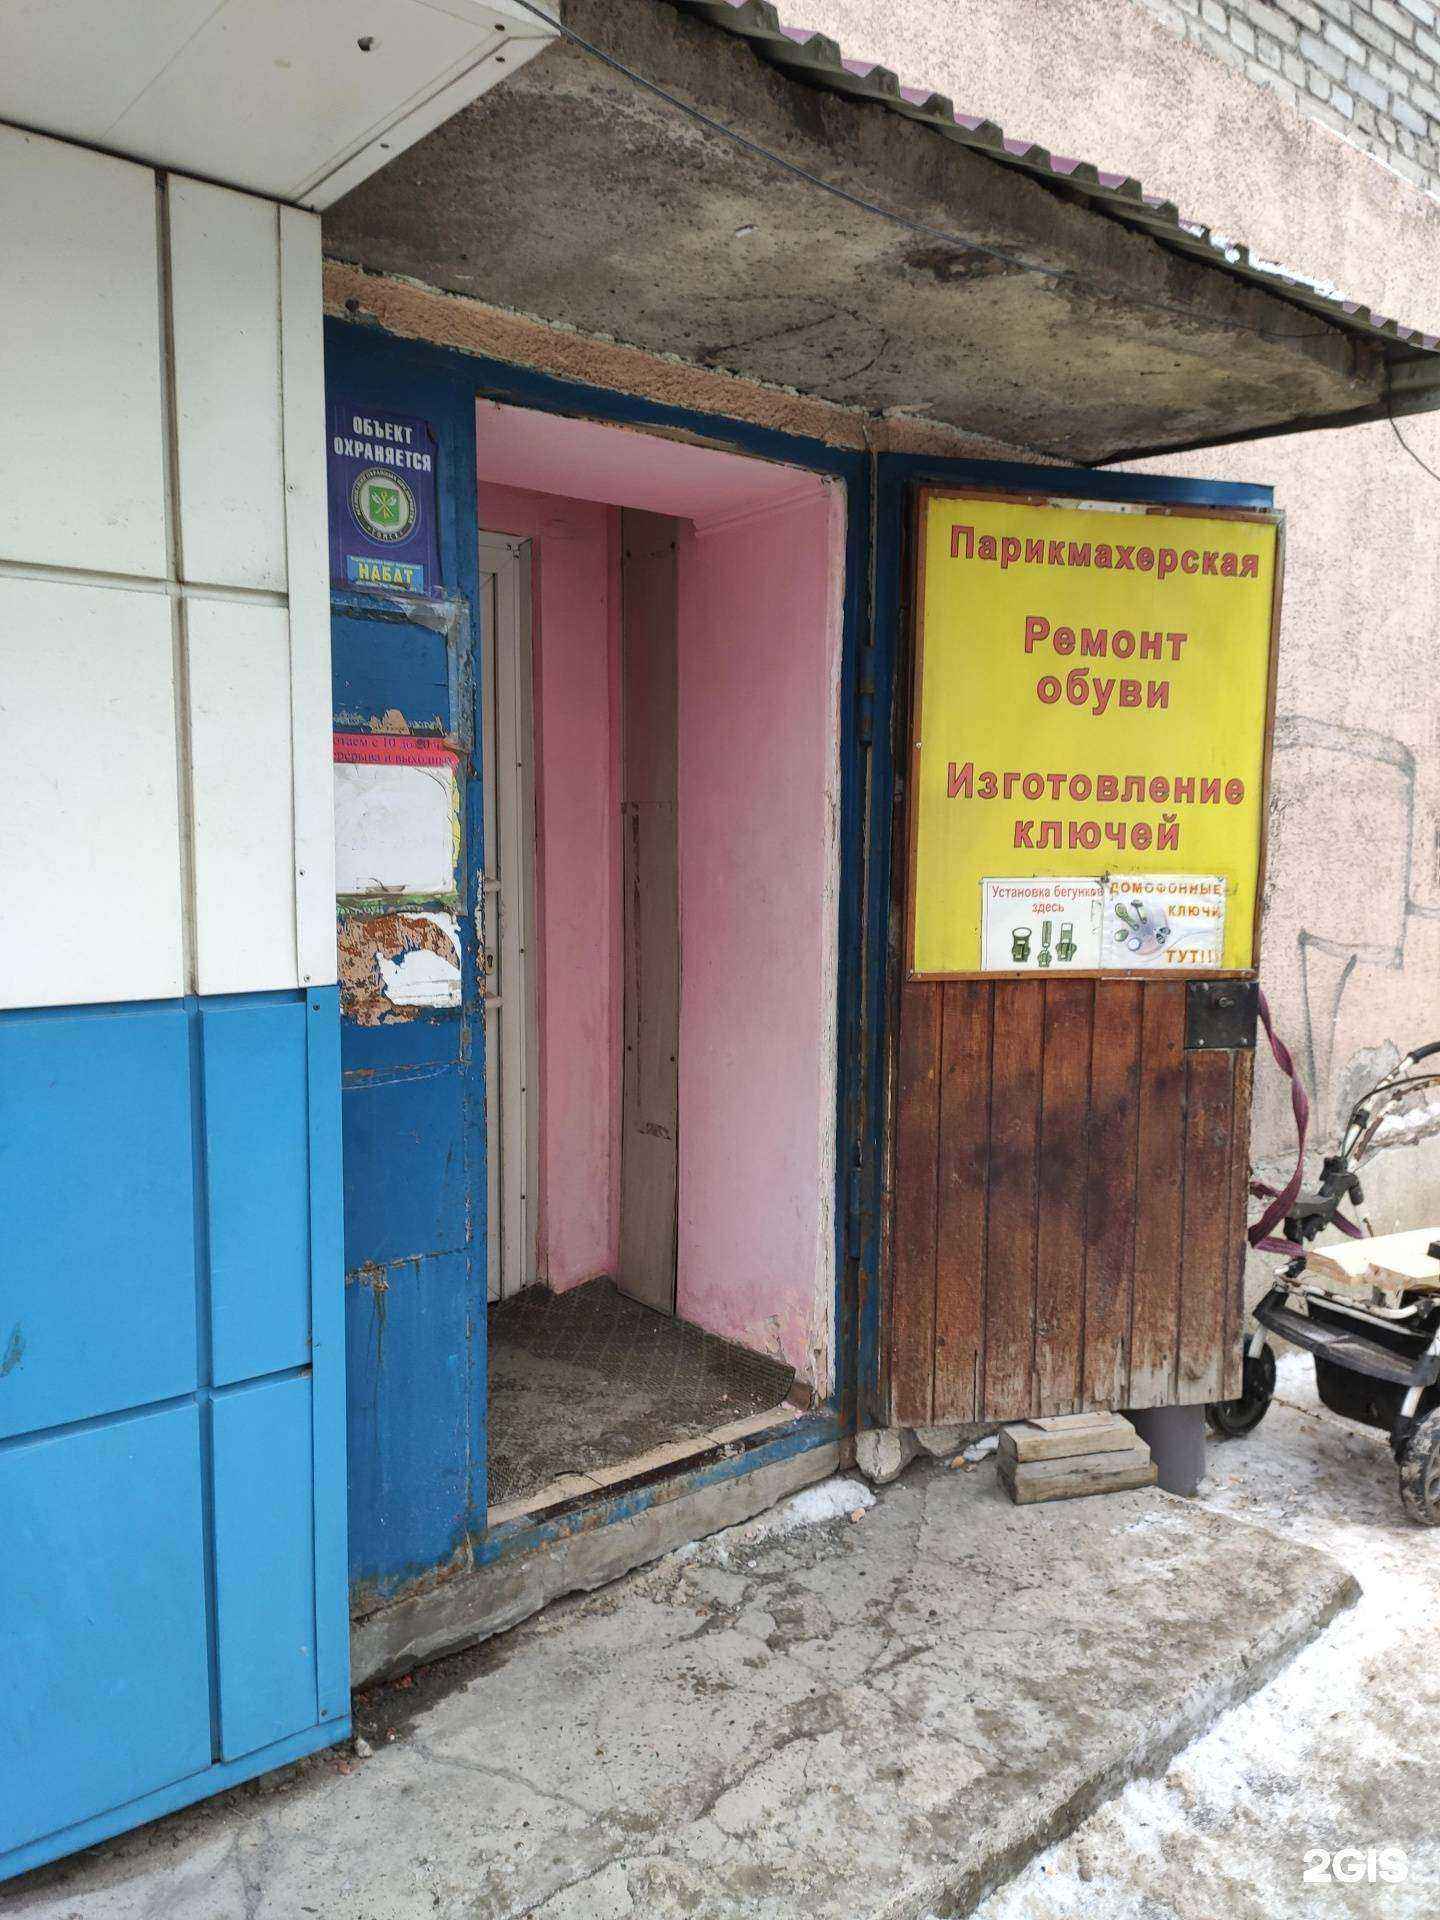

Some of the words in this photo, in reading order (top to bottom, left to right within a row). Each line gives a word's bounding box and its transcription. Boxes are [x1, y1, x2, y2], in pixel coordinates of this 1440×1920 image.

[352, 415, 413, 444] ОБЪЕКТ
[333, 436, 432, 472] ОХРАНЯЕТСЯ
[949, 524, 1259, 579] Парикмахерская
[358, 562, 413, 584] НАБАТ
[1024, 616, 1187, 660] Ремонт
[1036, 668, 1171, 715] обуви
[946, 761, 1246, 807] Изготовление
[1013, 813, 1181, 851] ключей
[991, 884, 1051, 899] Установка
[1031, 902, 1065, 915] здесь
